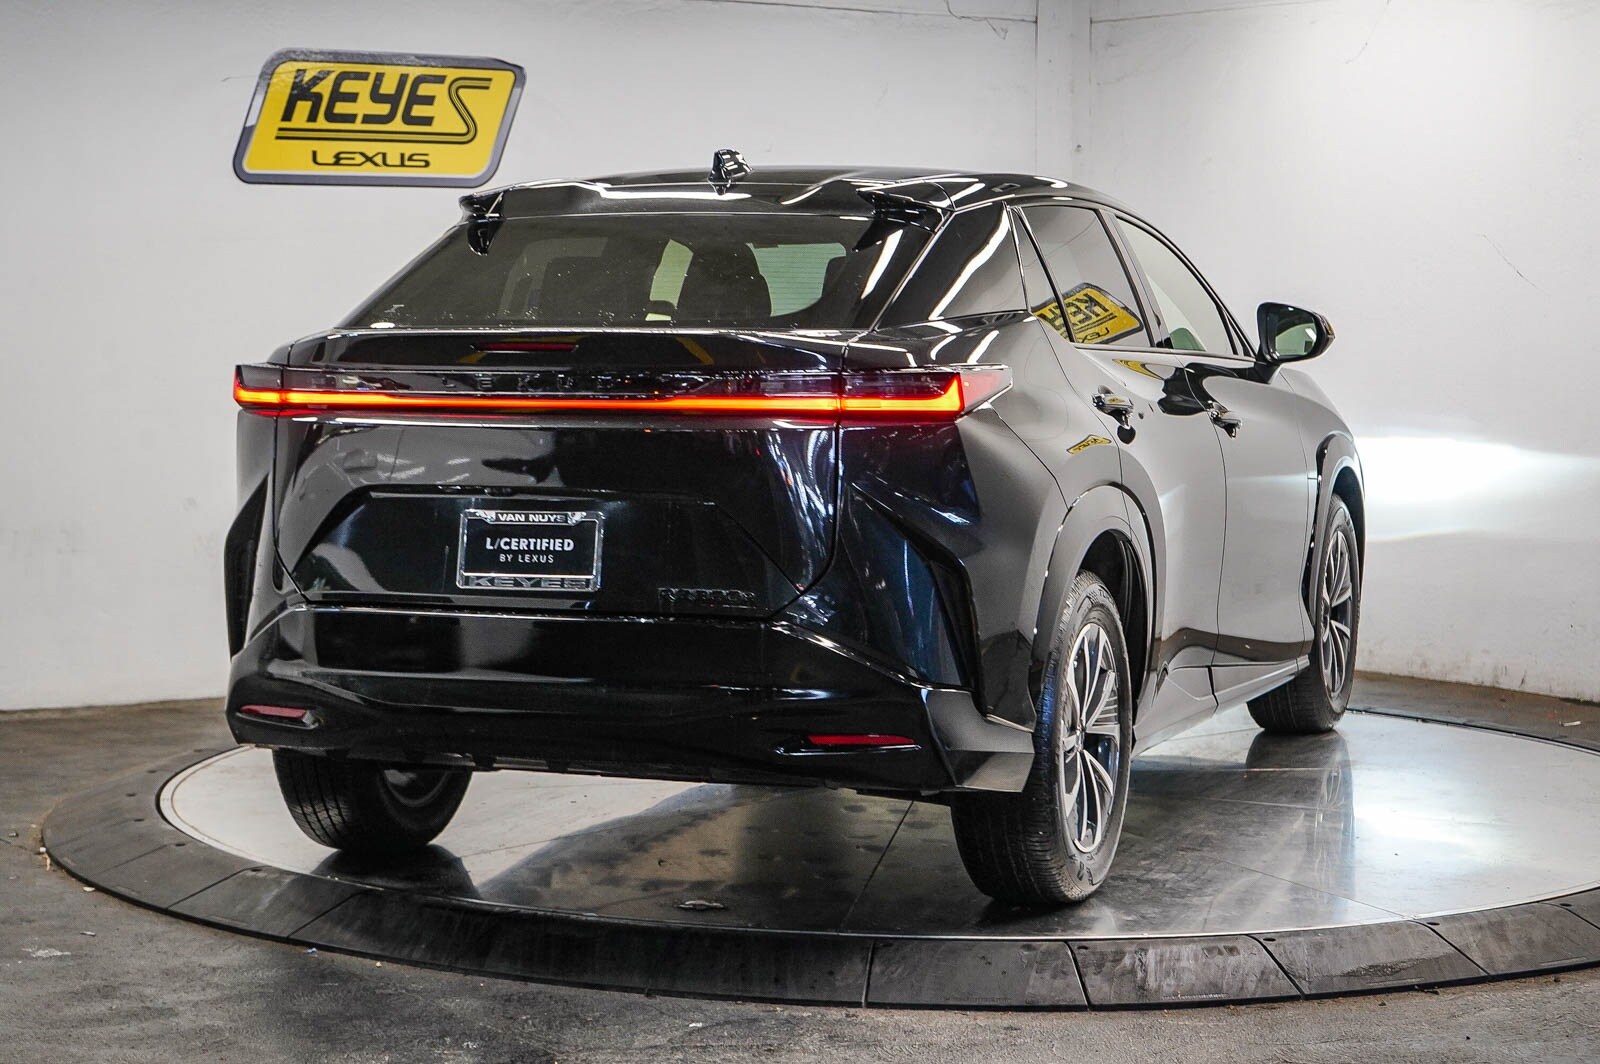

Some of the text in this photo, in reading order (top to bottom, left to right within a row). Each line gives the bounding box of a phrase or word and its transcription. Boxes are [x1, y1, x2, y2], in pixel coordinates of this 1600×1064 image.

[278, 68, 492, 144] KEYES
[312, 150, 430, 168] LEXUS
[497, 513, 566, 523] VAN NUYS
[485, 537, 574, 551] L/CERTIFIED
[499, 553, 554, 563] BY LEXUS
[469, 576, 586, 588] KEYES
